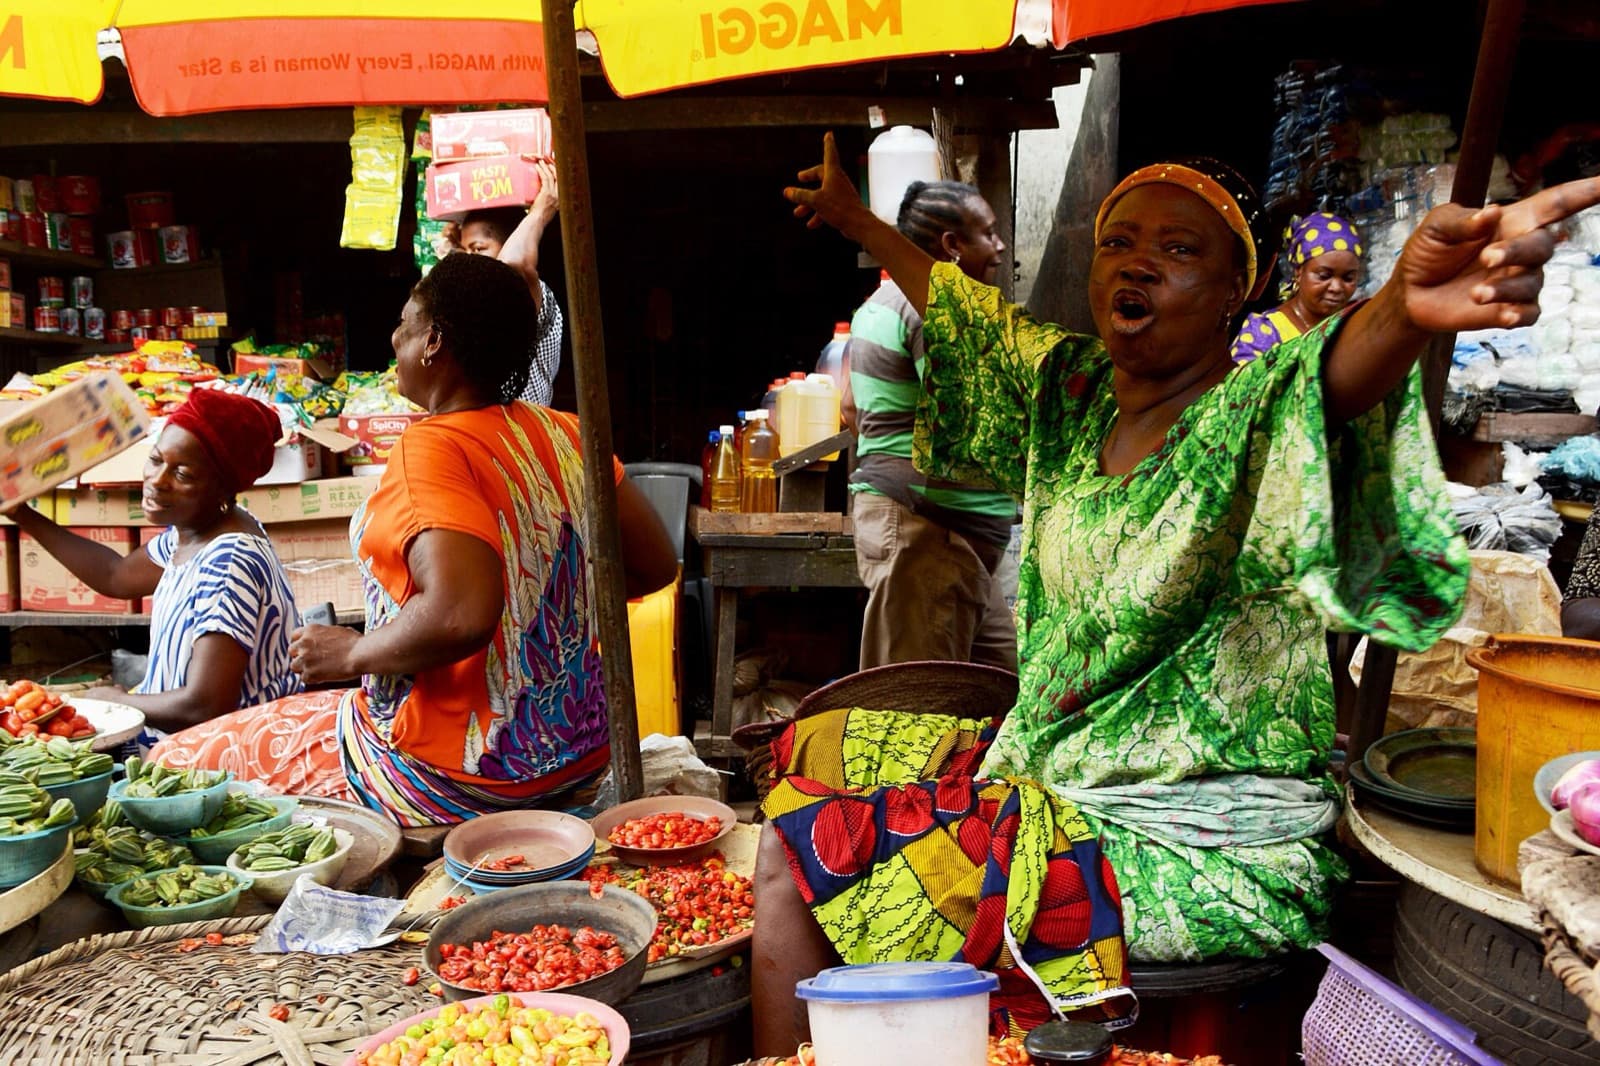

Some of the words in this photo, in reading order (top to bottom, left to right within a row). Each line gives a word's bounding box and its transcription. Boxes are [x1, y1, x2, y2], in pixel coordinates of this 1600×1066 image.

[471, 164, 507, 181] TASTY
[469, 177, 513, 201] TOM
[329, 491, 363, 502] REAL
